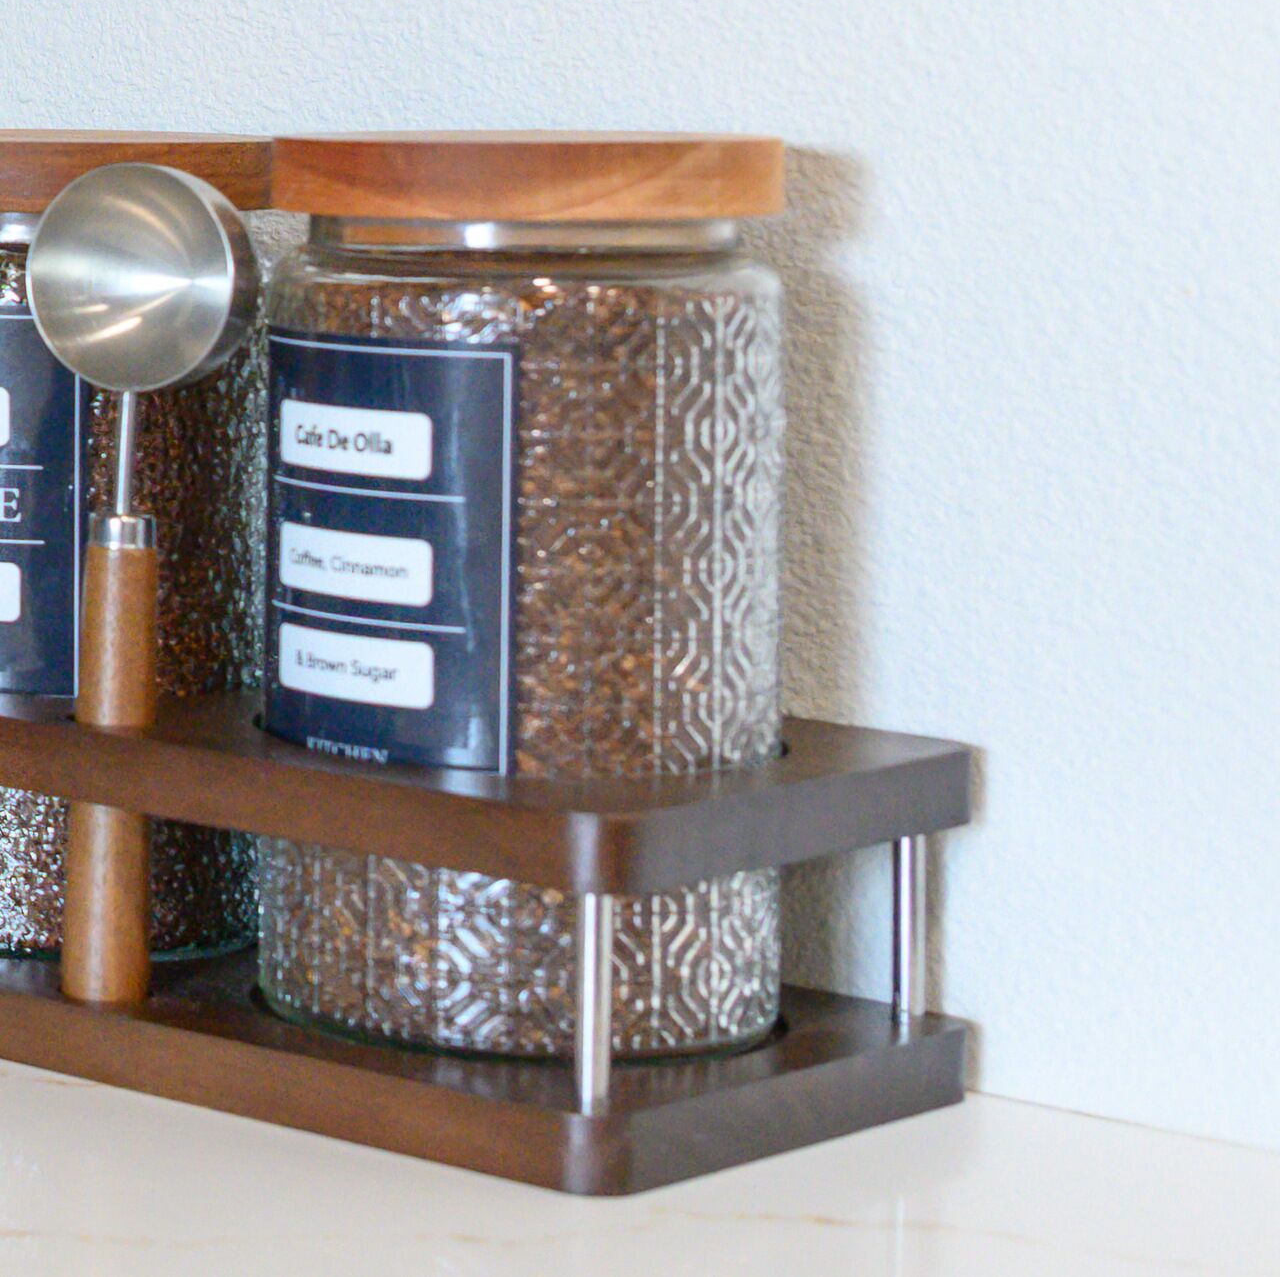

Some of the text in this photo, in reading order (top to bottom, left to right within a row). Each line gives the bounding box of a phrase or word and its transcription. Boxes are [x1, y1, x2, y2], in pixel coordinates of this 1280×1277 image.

[295, 424, 394, 455] Cafe De Olla
[350, 658, 400, 685] Sugar
